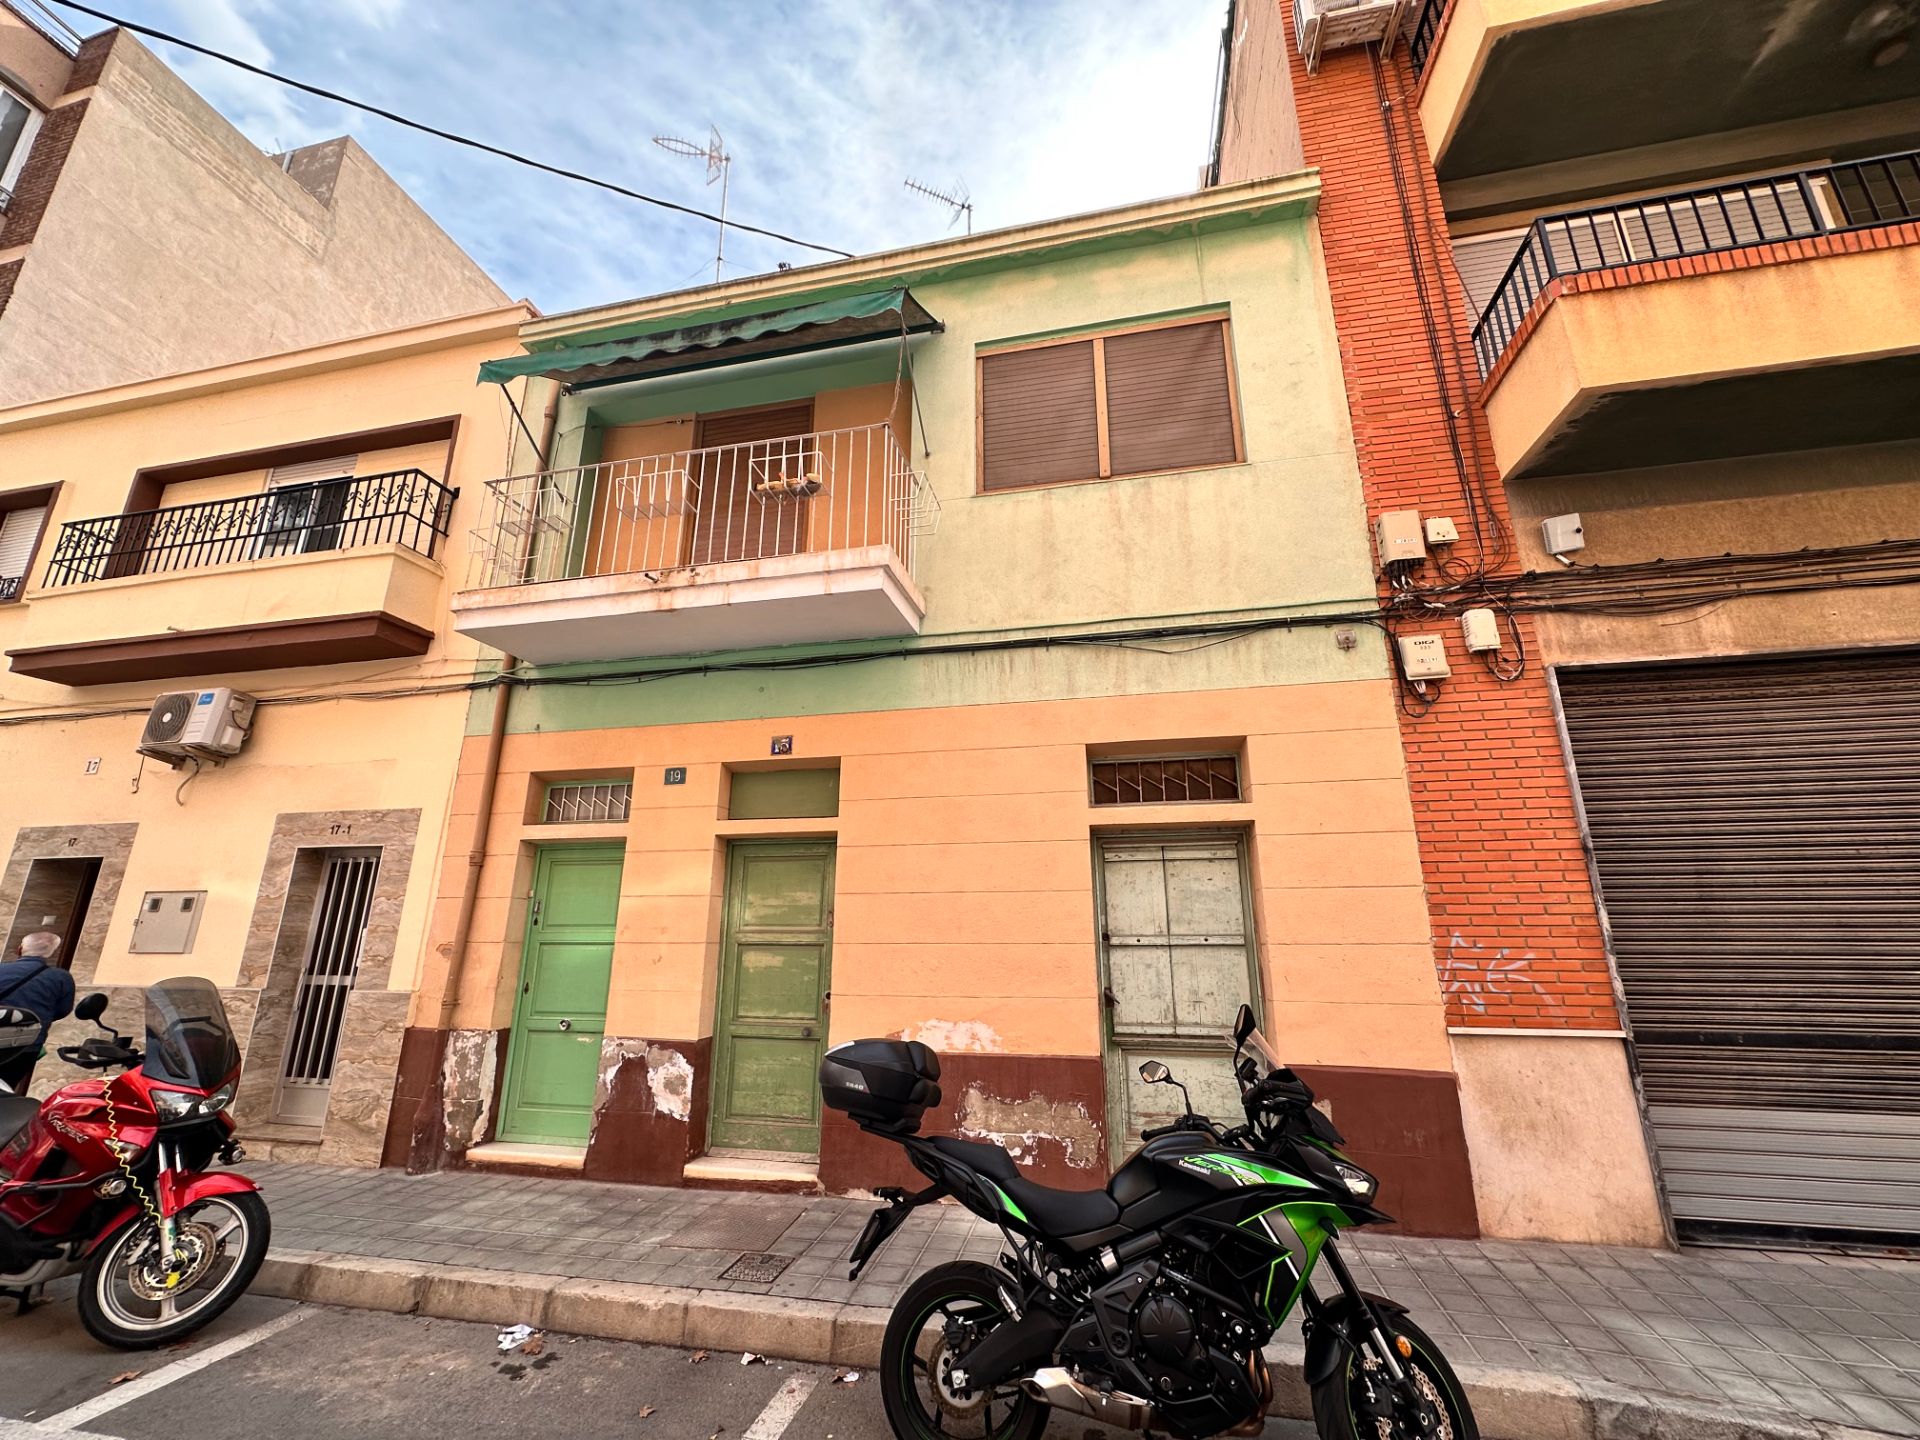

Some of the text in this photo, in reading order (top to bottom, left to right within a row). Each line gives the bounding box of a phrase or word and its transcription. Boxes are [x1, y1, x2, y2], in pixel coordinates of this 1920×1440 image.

[86, 760, 98, 772] 17
[670, 770, 681, 782] 19
[68, 838, 78, 847] 17
[1178, 1159, 1211, 1175] Kawasaki
